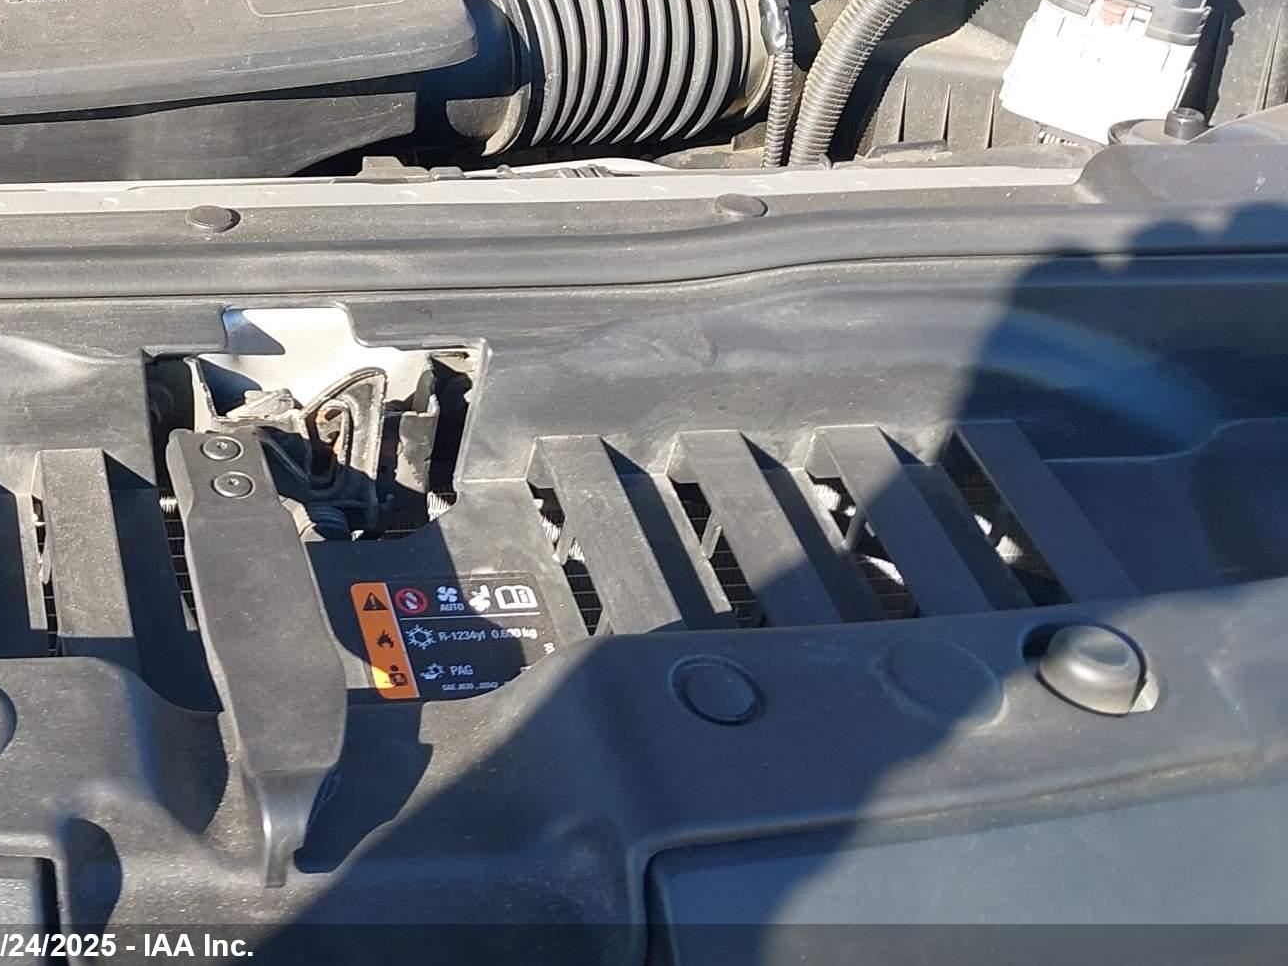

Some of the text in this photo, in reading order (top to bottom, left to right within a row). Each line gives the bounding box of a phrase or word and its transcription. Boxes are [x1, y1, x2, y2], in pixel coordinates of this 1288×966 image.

[440, 603, 464, 612] AUTO
[521, 627, 538, 639] kg
[450, 664, 474, 676] PAG
